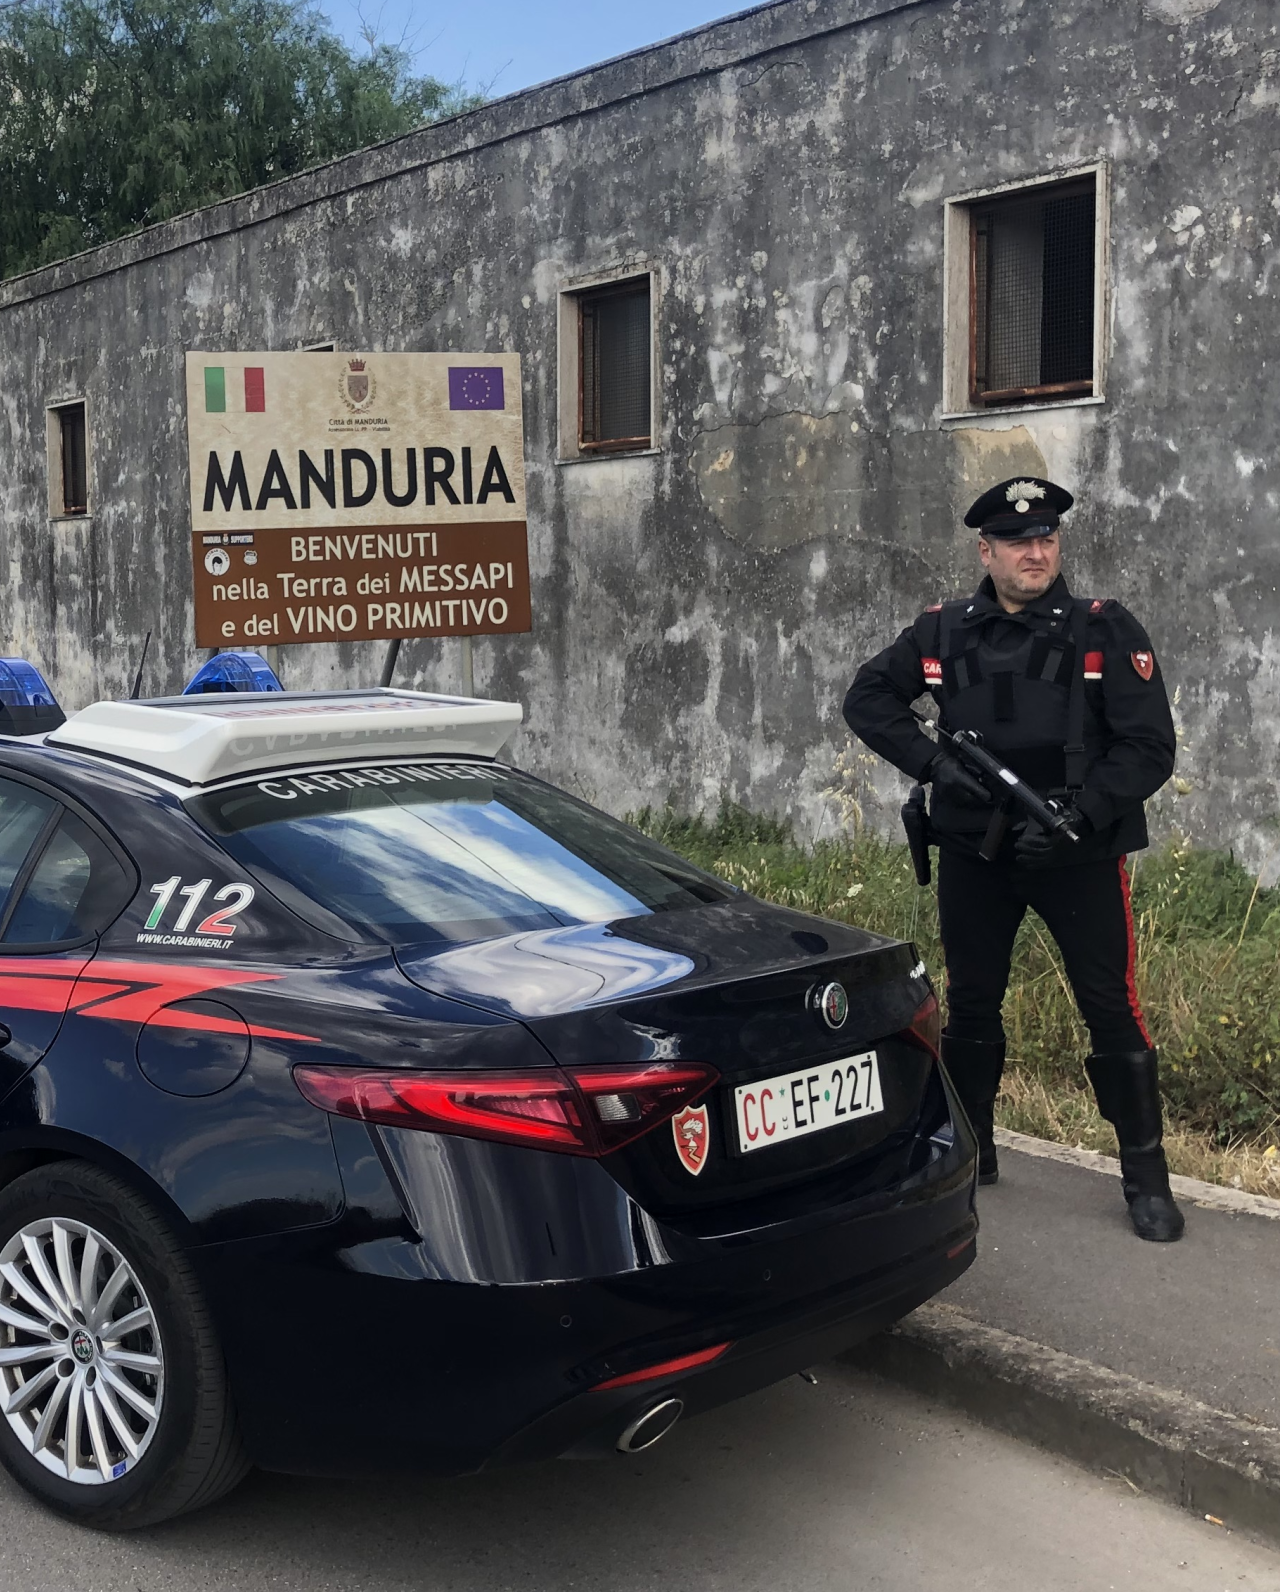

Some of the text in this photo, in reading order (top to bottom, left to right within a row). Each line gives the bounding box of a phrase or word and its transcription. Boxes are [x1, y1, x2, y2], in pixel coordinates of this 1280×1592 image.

[328, 418, 345, 426] Città
[203, 445, 516, 512] MANDURIA
[290, 532, 438, 562] BENVENUTI
[212, 562, 514, 601] nella Terra dei MESSAPI
[221, 597, 509, 638] e del VINO PRIMITIVO
[257, 764, 509, 801] CARABINIERI
[144, 876, 255, 936] 112
[136, 933, 234, 950] WWW.CARABINIERI.IT
[743, 1060, 873, 1142] CC EF 227
